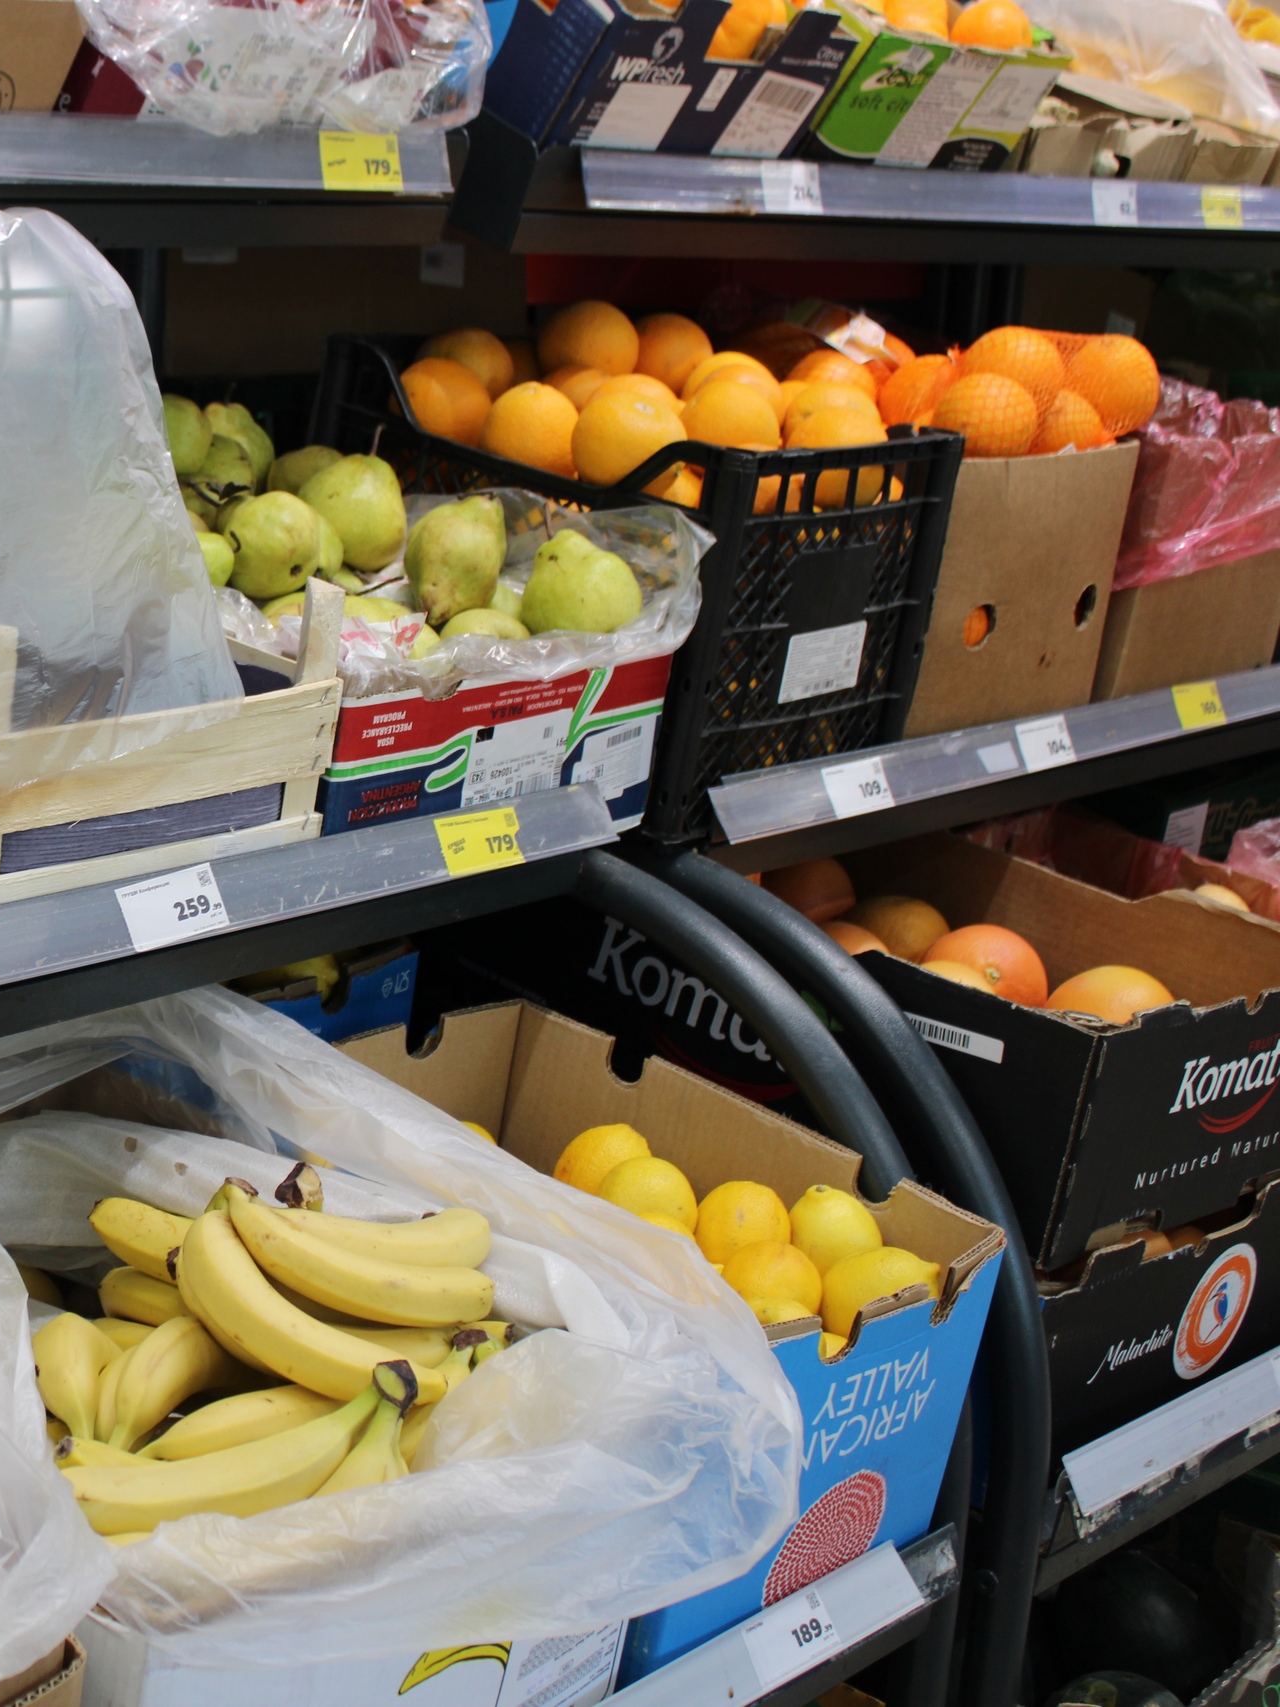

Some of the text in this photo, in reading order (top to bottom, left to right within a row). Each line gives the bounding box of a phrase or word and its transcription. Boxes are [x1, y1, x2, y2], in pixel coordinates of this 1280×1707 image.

[364, 158, 391, 175] 179
[527, 698, 564, 711] EXPORTADOR
[373, 711, 407, 724] PROGRAM
[361, 722, 413, 739] PRECLEARANCE
[377, 736, 395, 748] USDA
[361, 780, 422, 803] ARGENTINA
[858, 780, 882, 799] 109
[485, 834, 514, 854] 179
[173, 895, 211, 921] 259
[587, 916, 786, 1072] Koma
[1169, 1038, 1280, 1115] Komat
[1134, 1131, 1280, 1190] Nurtured Natur
[1086, 1323, 1174, 1385] Malachite
[812, 1346, 930, 1426] VALLEY
[791, 1618, 823, 1648] 189
